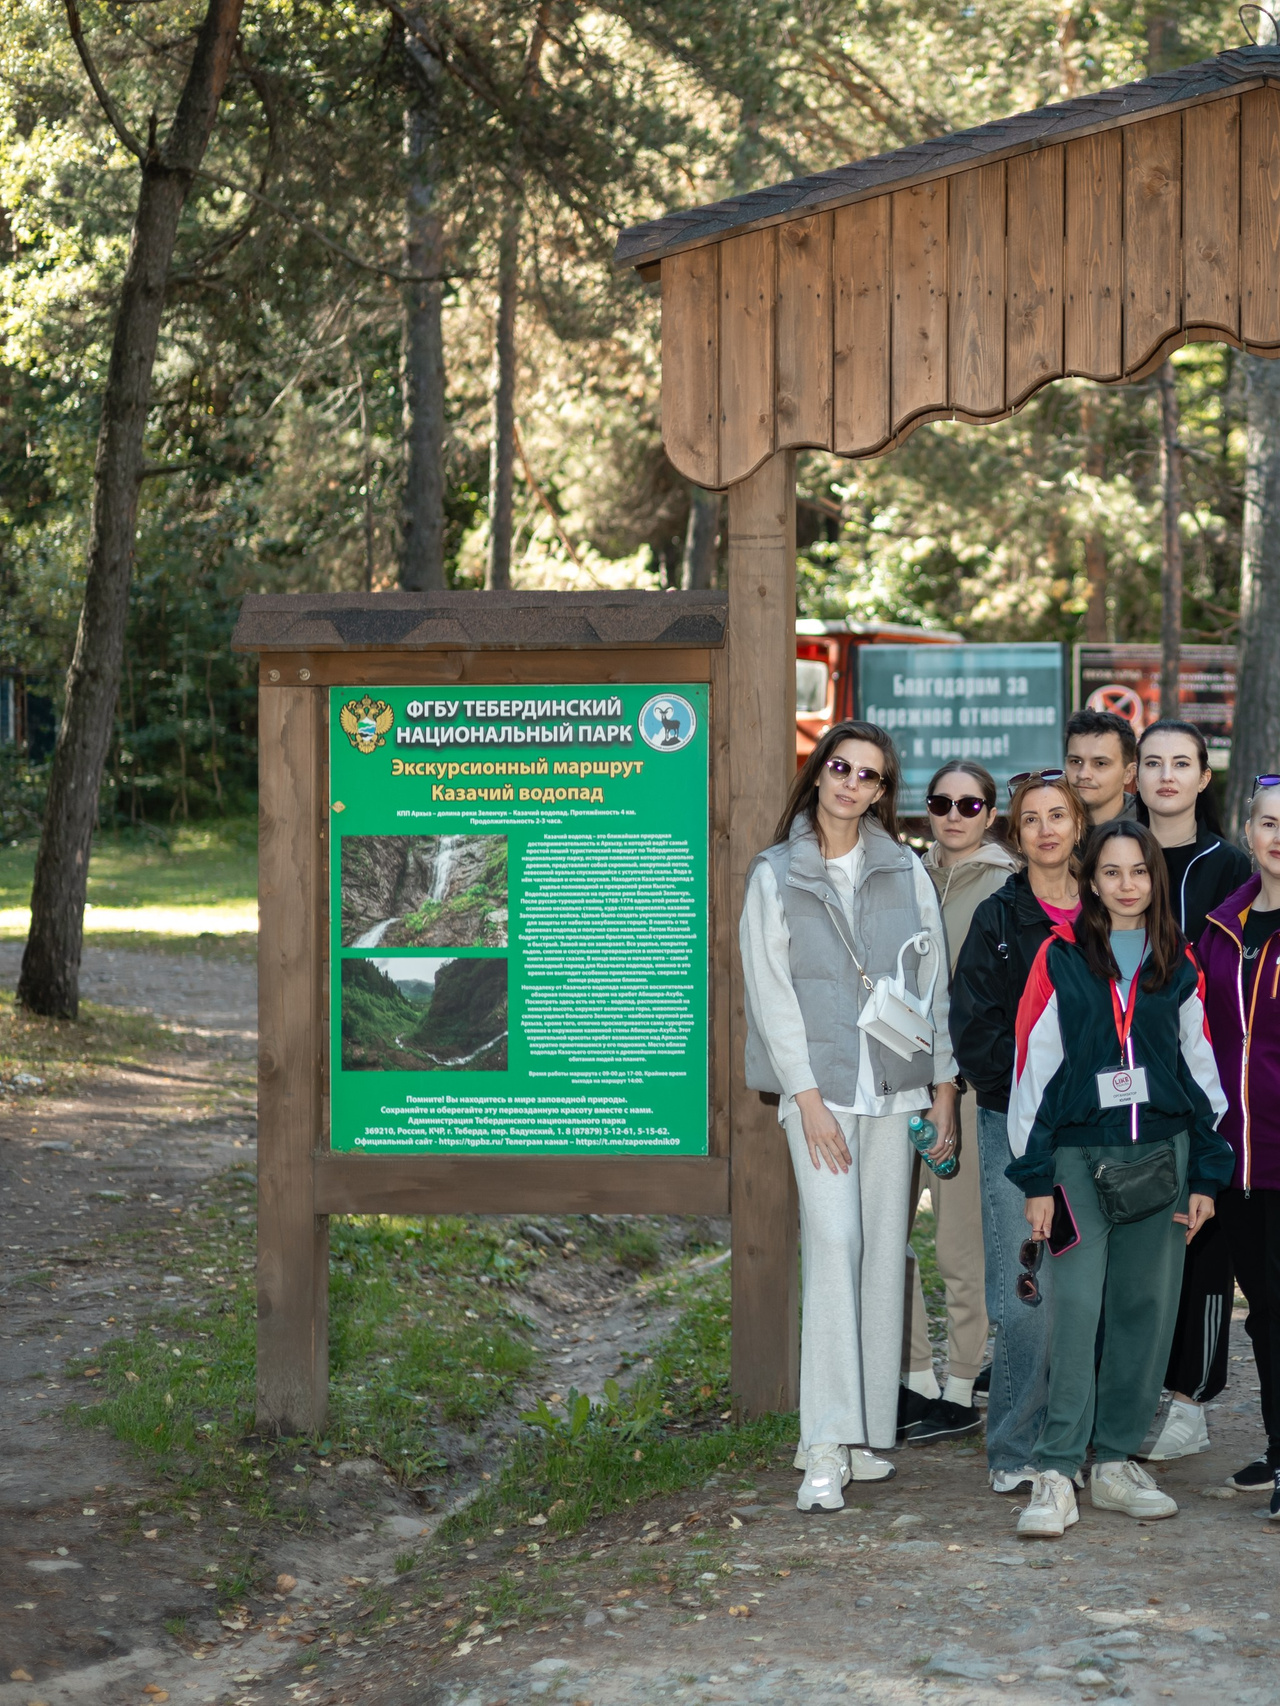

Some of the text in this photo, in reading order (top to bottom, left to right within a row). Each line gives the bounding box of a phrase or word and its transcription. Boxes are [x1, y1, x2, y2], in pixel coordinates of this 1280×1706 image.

[892, 674, 1028, 698] Благодарим за
[406, 696, 622, 720] ФГБУ ТЕБЕРДИНСКИЙ
[866, 704, 1057, 729] бережное отношение
[396, 722, 633, 747] НАЦИОНАЛЬНЫЙ ПАРК
[931, 734, 1011, 760] природе!
[391, 757, 644, 780] Экскурсионный маршрут
[431, 784, 604, 804] Казачий водопад
[411, 810, 432, 818] Архыз
[478, 809, 508, 818] Зеленчук
[570, 809, 620, 817] Протяжённость
[470, 817, 534, 826] Продолжительность
[1115, 1076, 1130, 1085] LIKE
[406, 1095, 445, 1103] Помните!
[514, 1097, 536, 1105] мире
[537, 1095, 586, 1104] заповедной
[587, 1097, 628, 1105] природы.
[381, 1106, 428, 1115] Сохраняйте
[436, 1106, 483, 1115] оберегайте
[408, 1116, 473, 1126] Администрация
[475, 1116, 536, 1126] Тебердинского
[365, 1127, 396, 1137] 369210,
[397, 1127, 427, 1137] Россия,
[429, 1127, 446, 1137] КЧР,
[455, 1127, 490, 1137] Теберда,
[491, 1129, 509, 1137] пер.
[510, 1127, 555, 1137] Бадукский,
[572, 1127, 602, 1137] (87879)
[604, 1127, 636, 1137] 5-12-61,
[637, 1127, 670, 1135] 5-15-62.
[354, 1138, 414, 1147] Официальный
[505, 1138, 543, 1147] Телеграм
